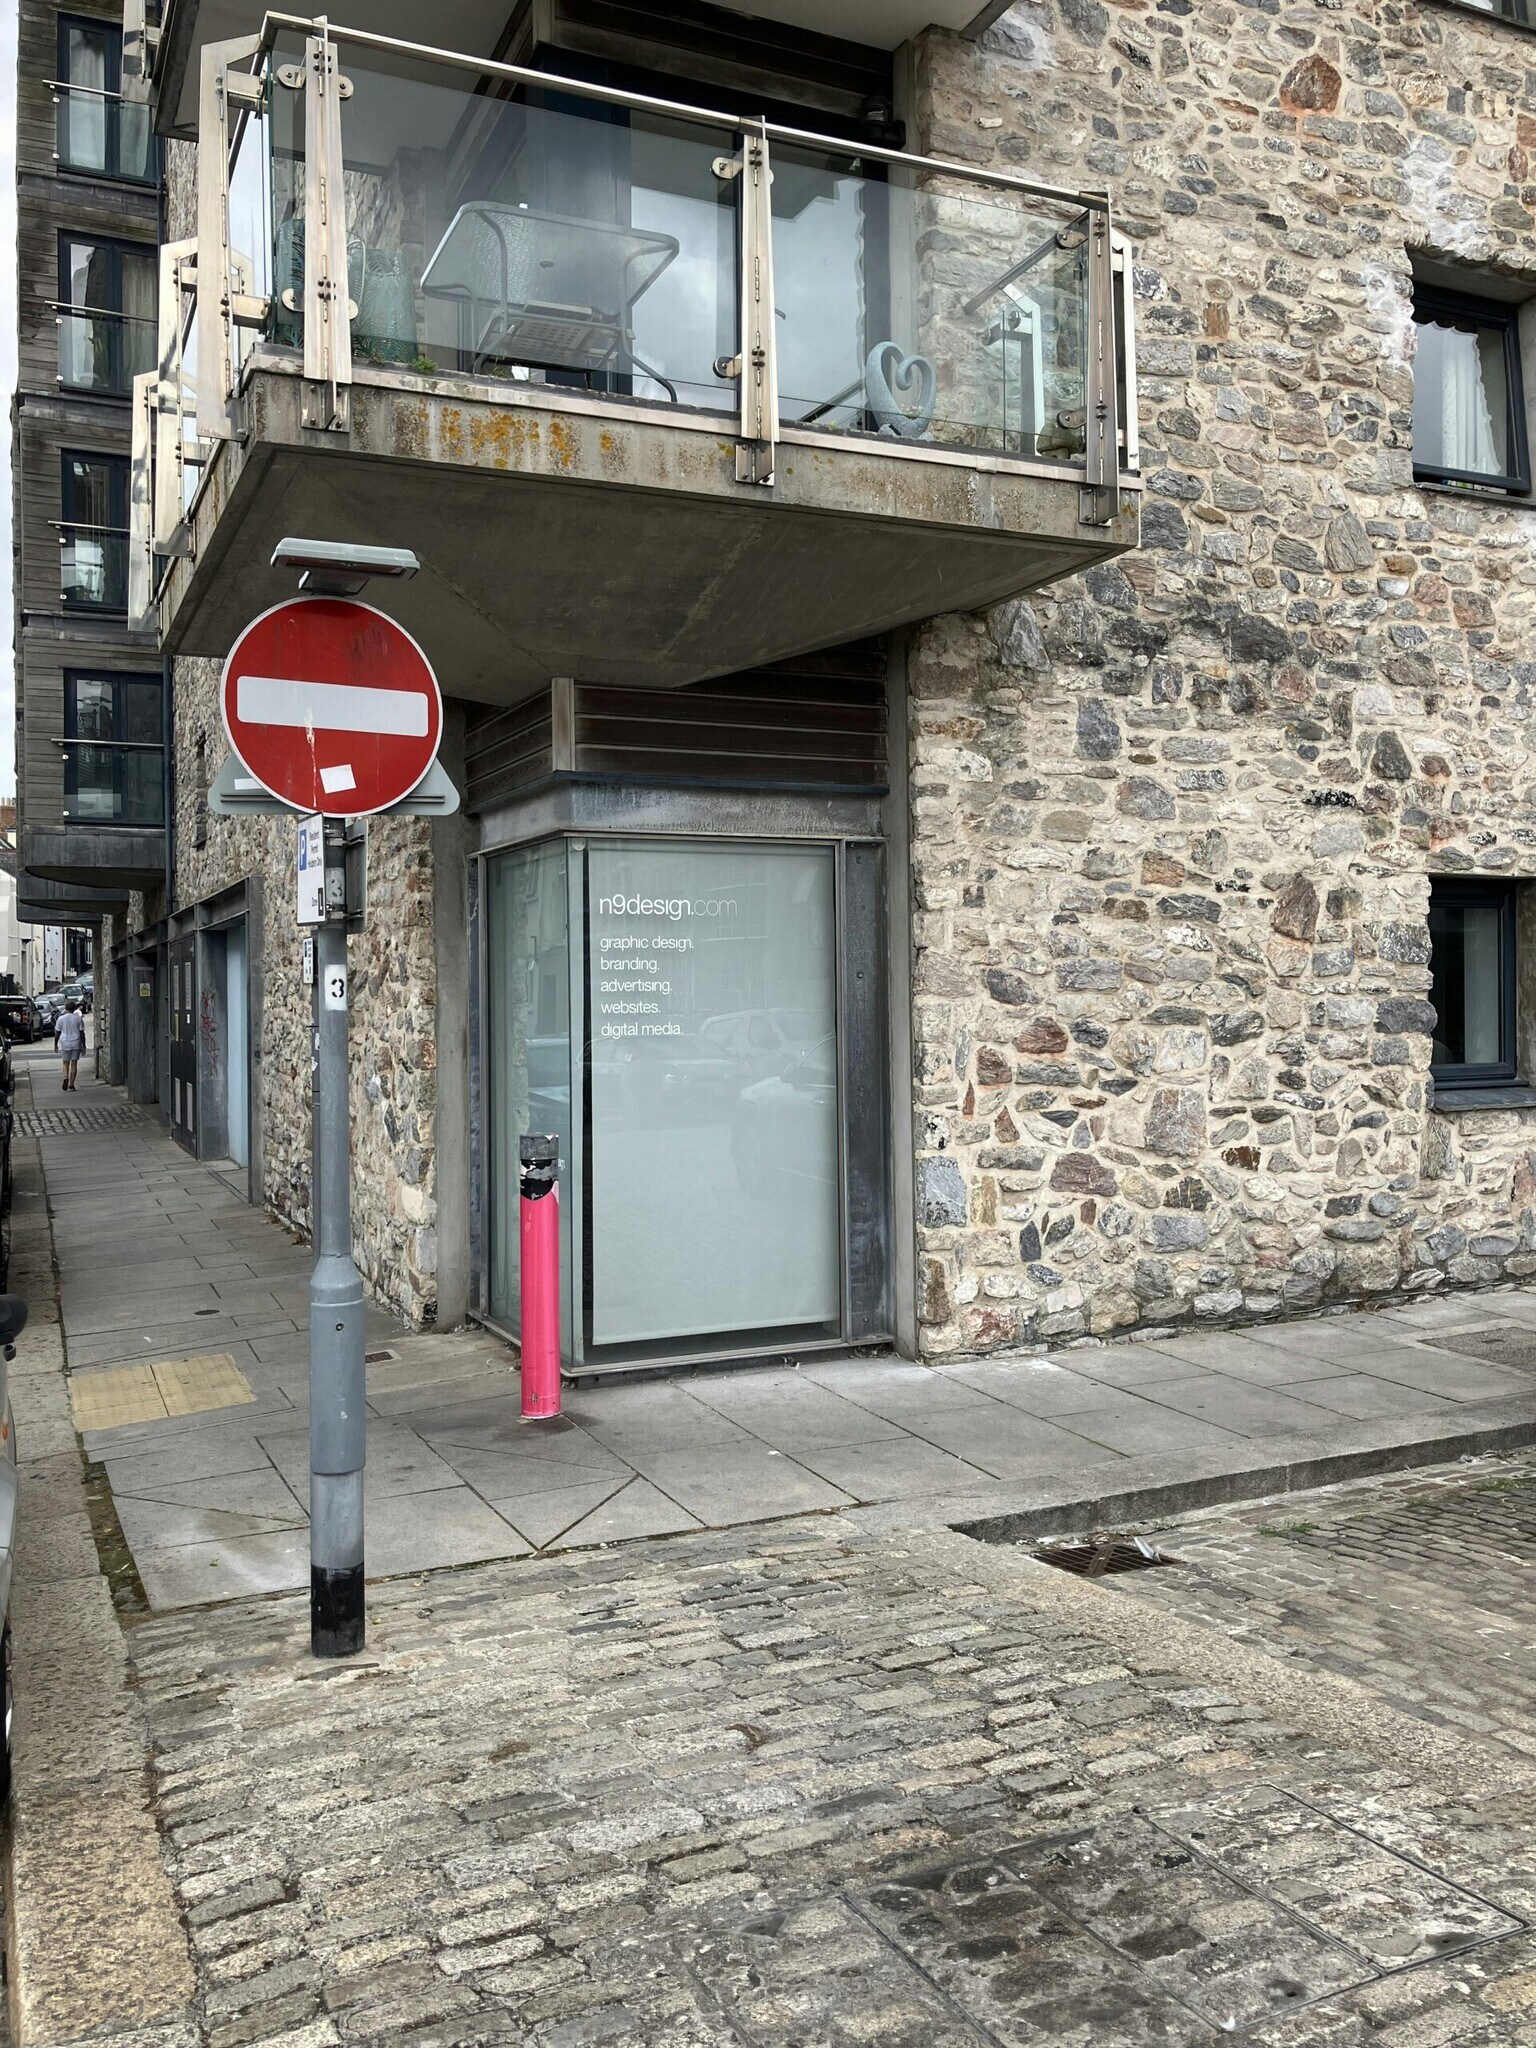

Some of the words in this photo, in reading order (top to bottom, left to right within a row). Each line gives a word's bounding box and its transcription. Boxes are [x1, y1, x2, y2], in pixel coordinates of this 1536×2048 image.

[599, 893, 738, 921] n9design.com
[600, 935, 649, 952] graphic
[652, 935, 694, 952] design.
[600, 956, 660, 974] branding.
[331, 978, 345, 998] 3
[600, 979, 673, 995] advertising.
[600, 1001, 661, 1014] websites.
[601, 1022, 638, 1040] digital
[641, 1022, 684, 1036] media.
